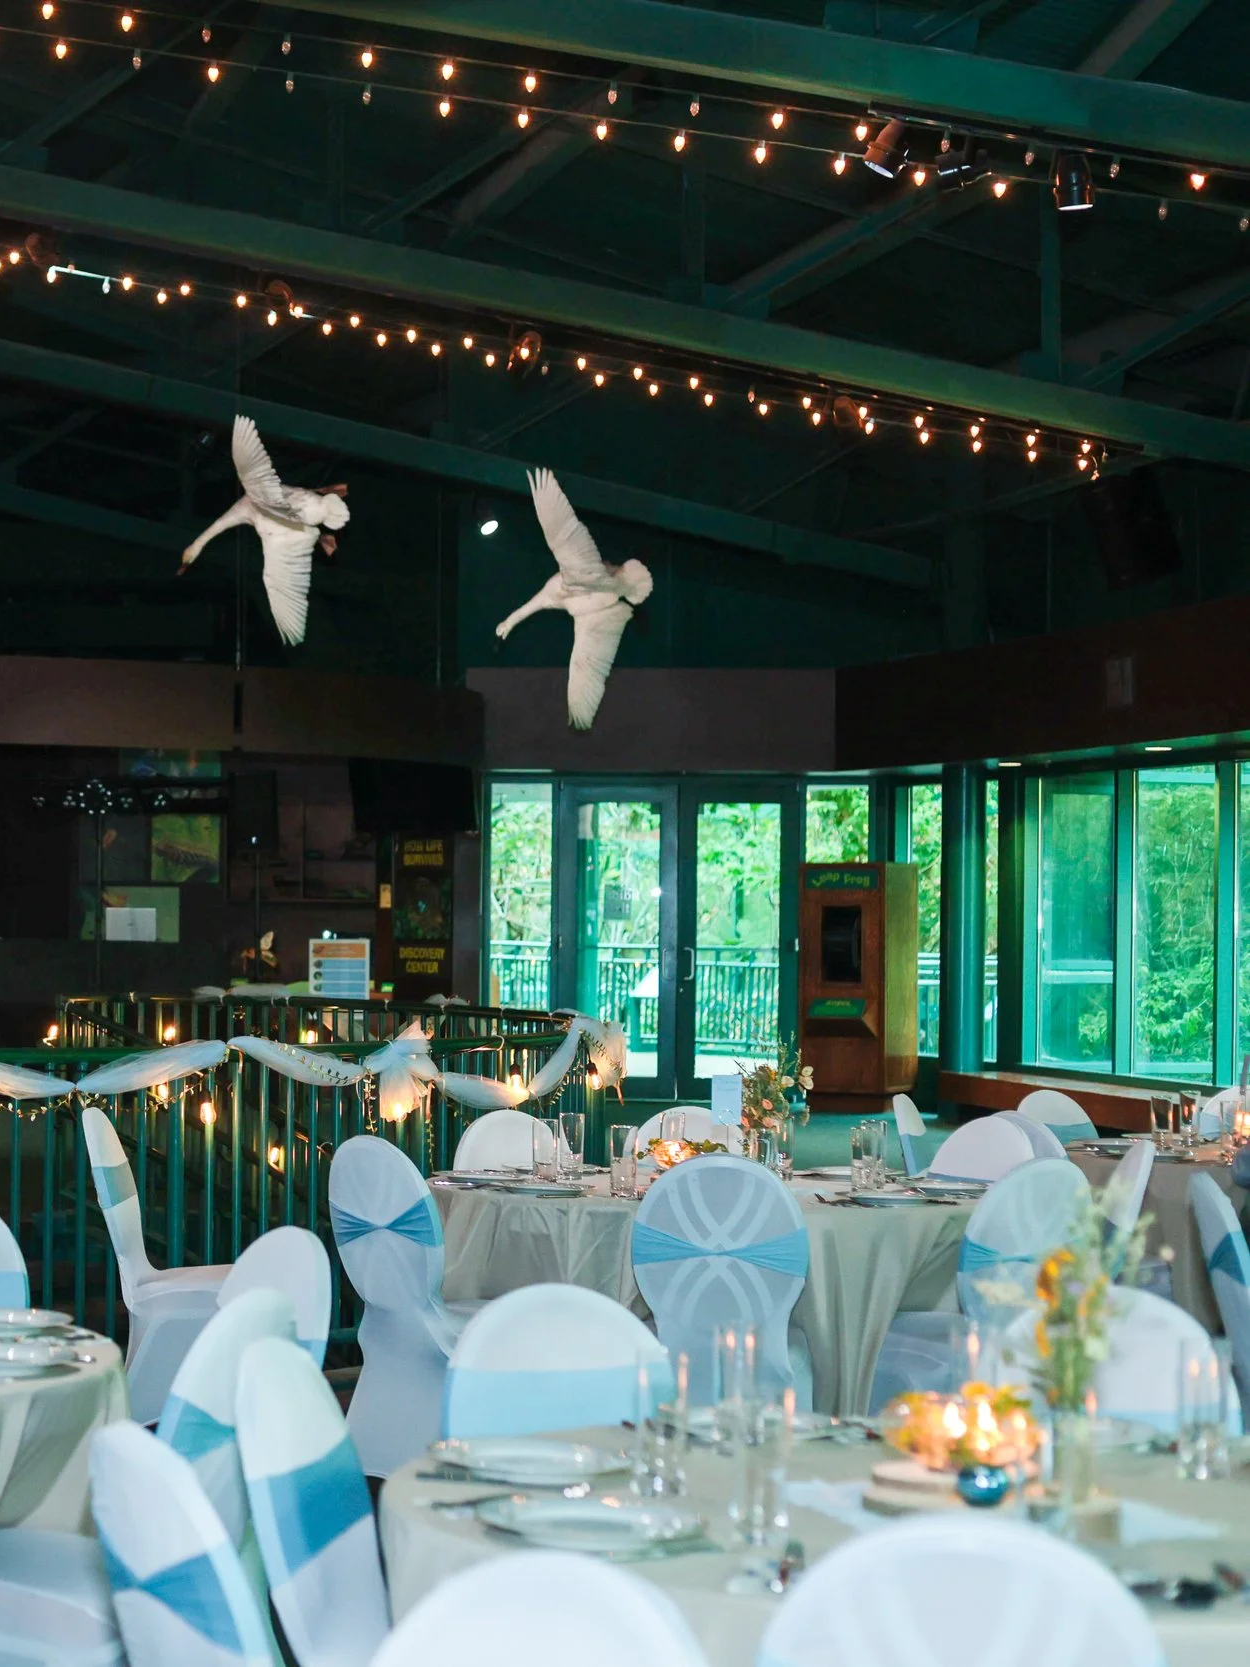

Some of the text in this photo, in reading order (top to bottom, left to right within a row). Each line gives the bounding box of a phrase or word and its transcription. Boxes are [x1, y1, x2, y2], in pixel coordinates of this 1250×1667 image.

[425, 839, 443, 851] LIFE
[844, 873, 870, 887] Frog
[399, 947, 445, 960] DISCOVERY
[406, 961, 438, 973] CENTER
